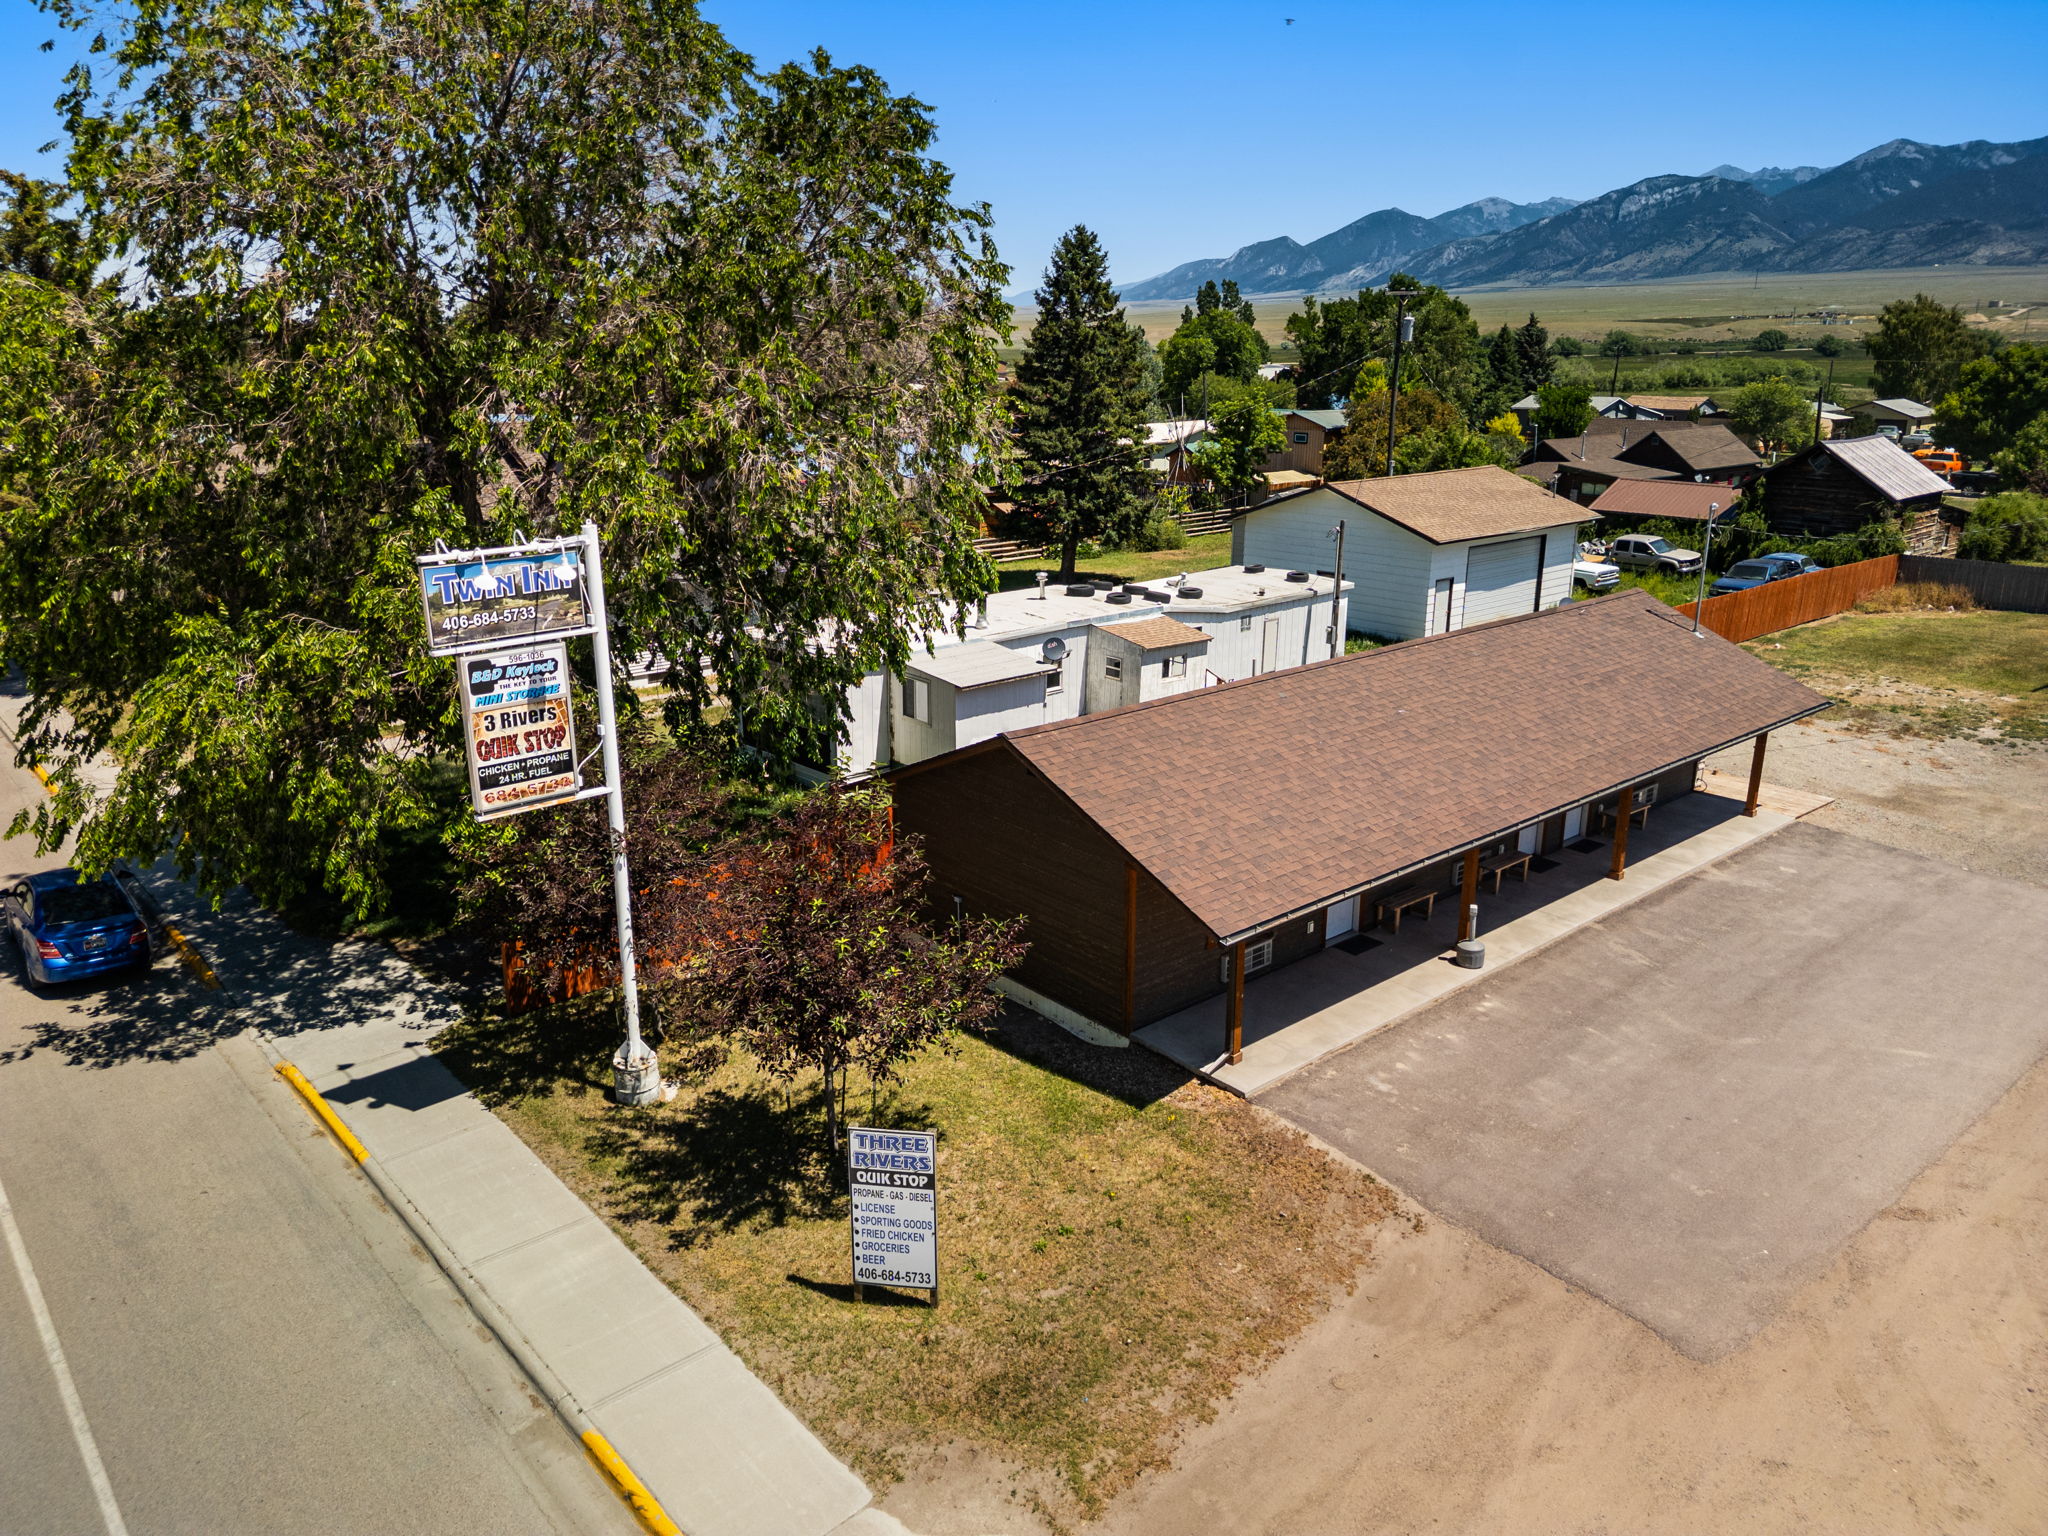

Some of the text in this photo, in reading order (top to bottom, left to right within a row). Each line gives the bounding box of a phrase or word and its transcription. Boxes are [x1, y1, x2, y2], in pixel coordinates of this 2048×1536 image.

[442, 606, 536, 631] 406-684-5733
[508, 651, 545, 663] 596-1036
[471, 659, 556, 684] B&D Keylock
[475, 683, 560, 707] MINI STORAGE
[484, 706, 557, 732] 3 Rivers
[476, 725, 567, 762] QUIK STOP
[479, 751, 570, 777] CHICKEN PROPANE
[498, 766, 553, 785] 24 HR. FUEL
[853, 1132, 929, 1154] THREE
[853, 1150, 932, 1172] RIVERS
[856, 1170, 929, 1188] QUIK STOP
[853, 1187, 933, 1203] PROPANE GAS DIESEL
[860, 1202, 896, 1214] LICENSE
[860, 1215, 933, 1231] SPORTING GOODS
[861, 1228, 925, 1243] FRIED CHICKEN
[861, 1241, 910, 1254] GROCERIES
[862, 1254, 886, 1265] BEER
[857, 1267, 931, 1285] 406-684-5733
